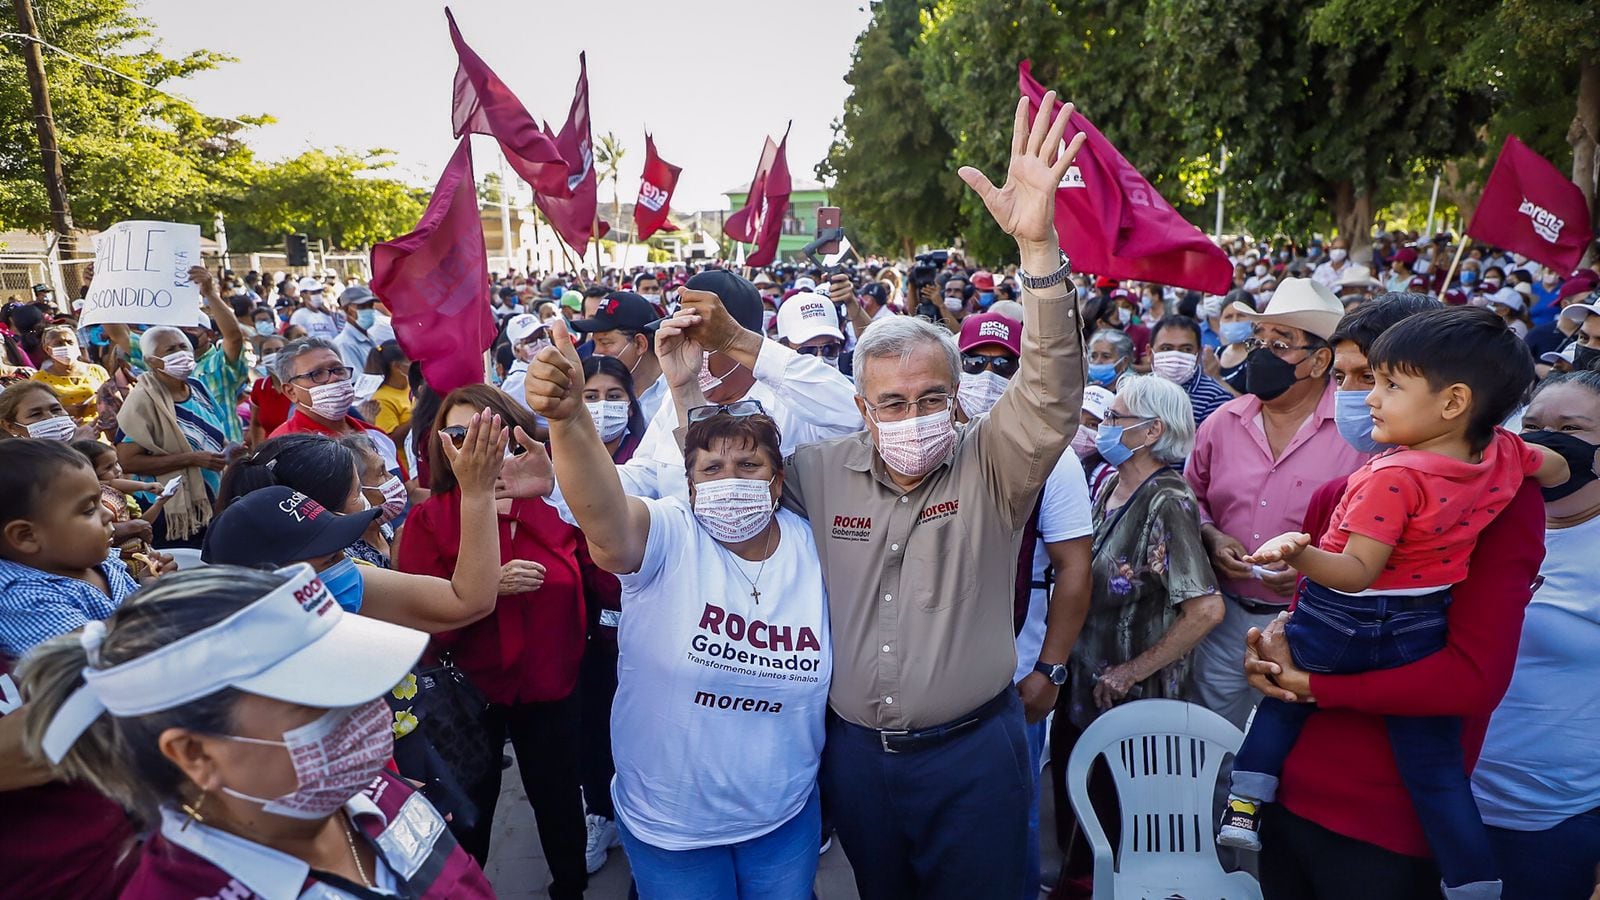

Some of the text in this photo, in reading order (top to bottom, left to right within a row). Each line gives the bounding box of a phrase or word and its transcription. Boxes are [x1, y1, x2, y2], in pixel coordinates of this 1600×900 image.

[641, 179, 669, 206] ena
[97, 230, 166, 274] ALLE
[174, 250, 190, 288] ROCHA
[91, 287, 172, 310] SCONDIDO
[800, 303, 825, 312] ROCHA
[980, 321, 1009, 333] ROCHA
[832, 528, 871, 538] Gobernador
[833, 515, 872, 530] ROCHA
[699, 602, 820, 652] ROCHA
[692, 634, 820, 672] Gobernador
[687, 652, 819, 683] Transformemos juntos Sinaloa
[694, 691, 783, 713] morena
[328, 751, 371, 774] ROCHA
